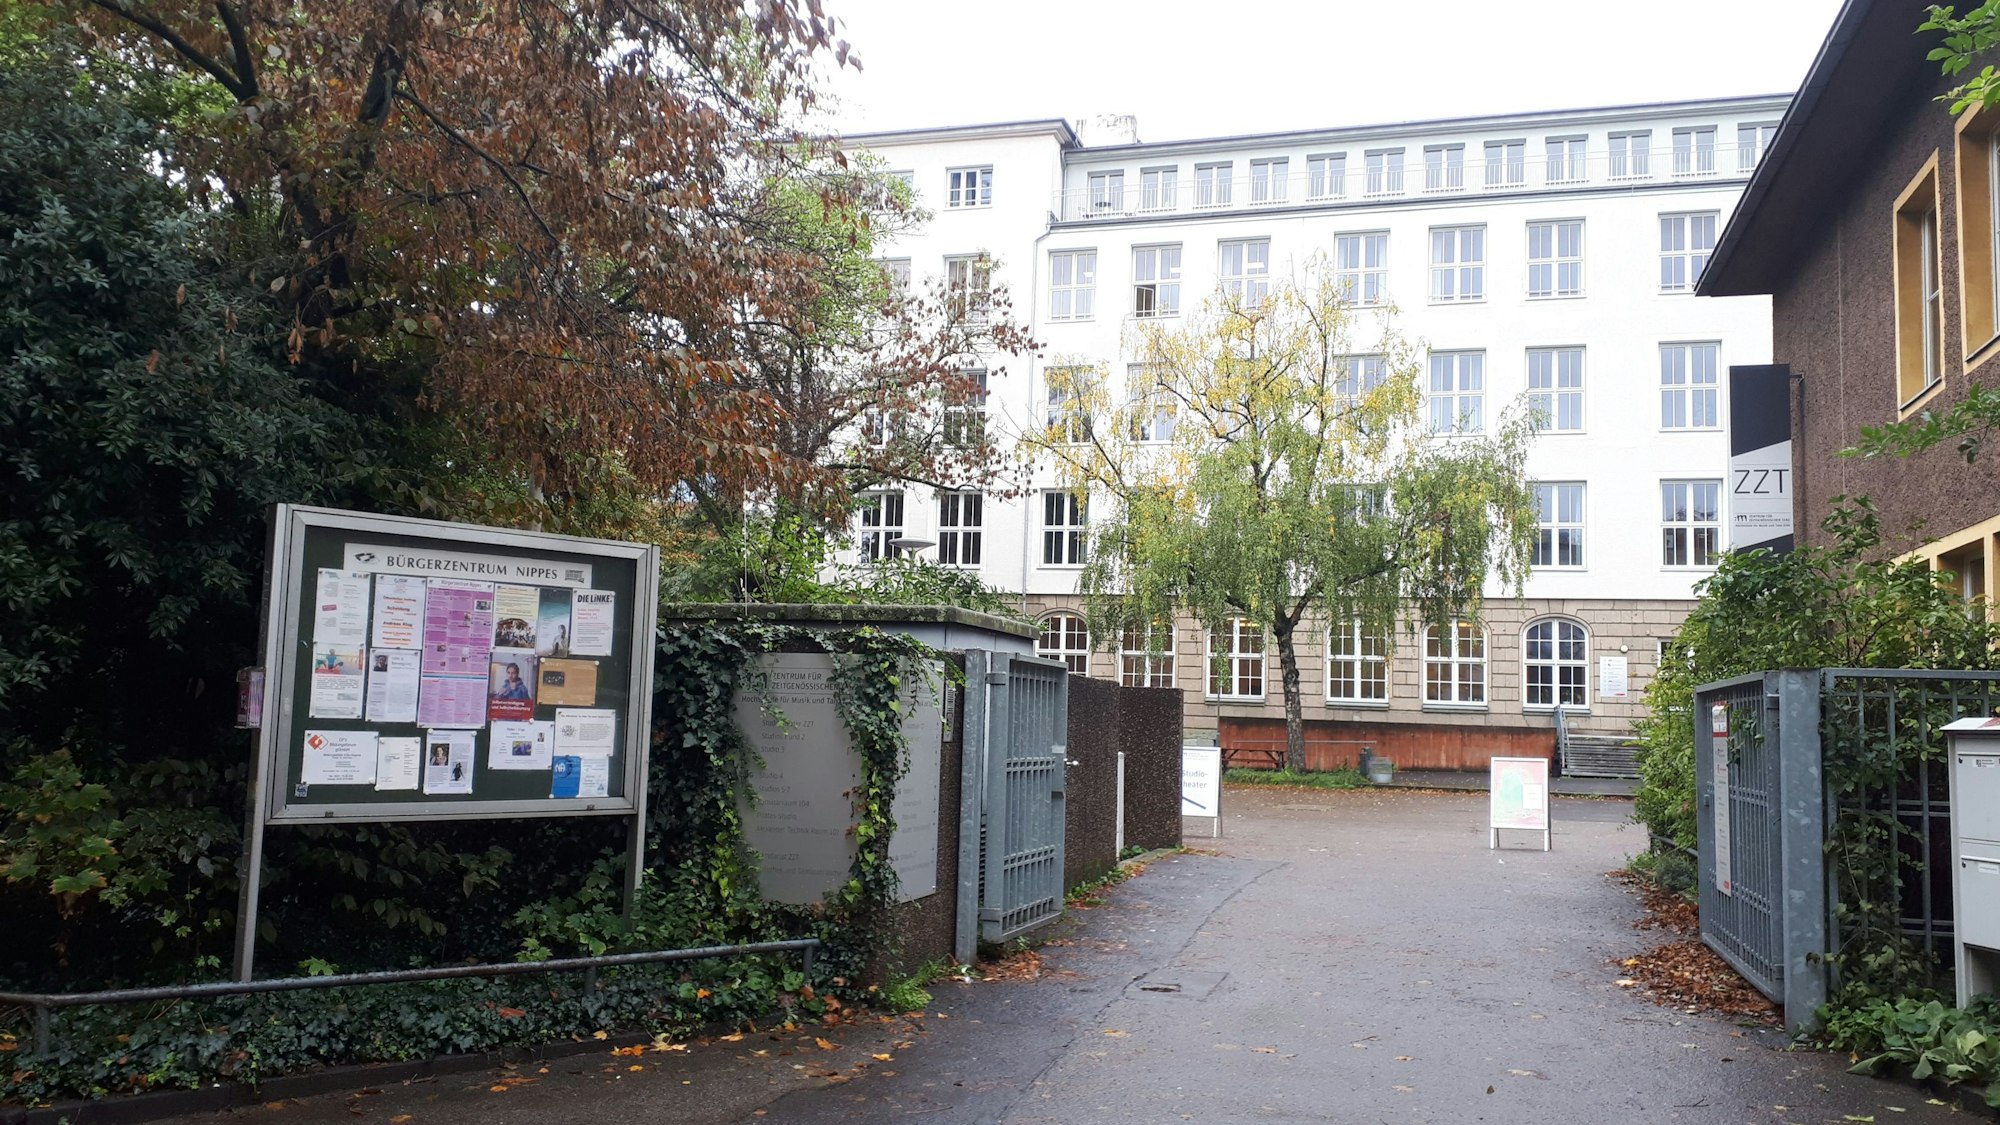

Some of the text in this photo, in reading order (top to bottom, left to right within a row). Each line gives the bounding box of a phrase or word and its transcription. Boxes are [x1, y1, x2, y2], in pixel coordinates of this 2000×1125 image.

[1735, 469, 1789, 494] ZZT
[387, 554, 558, 579] BÜRGERZENTRUM NIPPES
[577, 594, 589, 603] DIE
[773, 672, 822, 680] ZENTRUM FÜR
